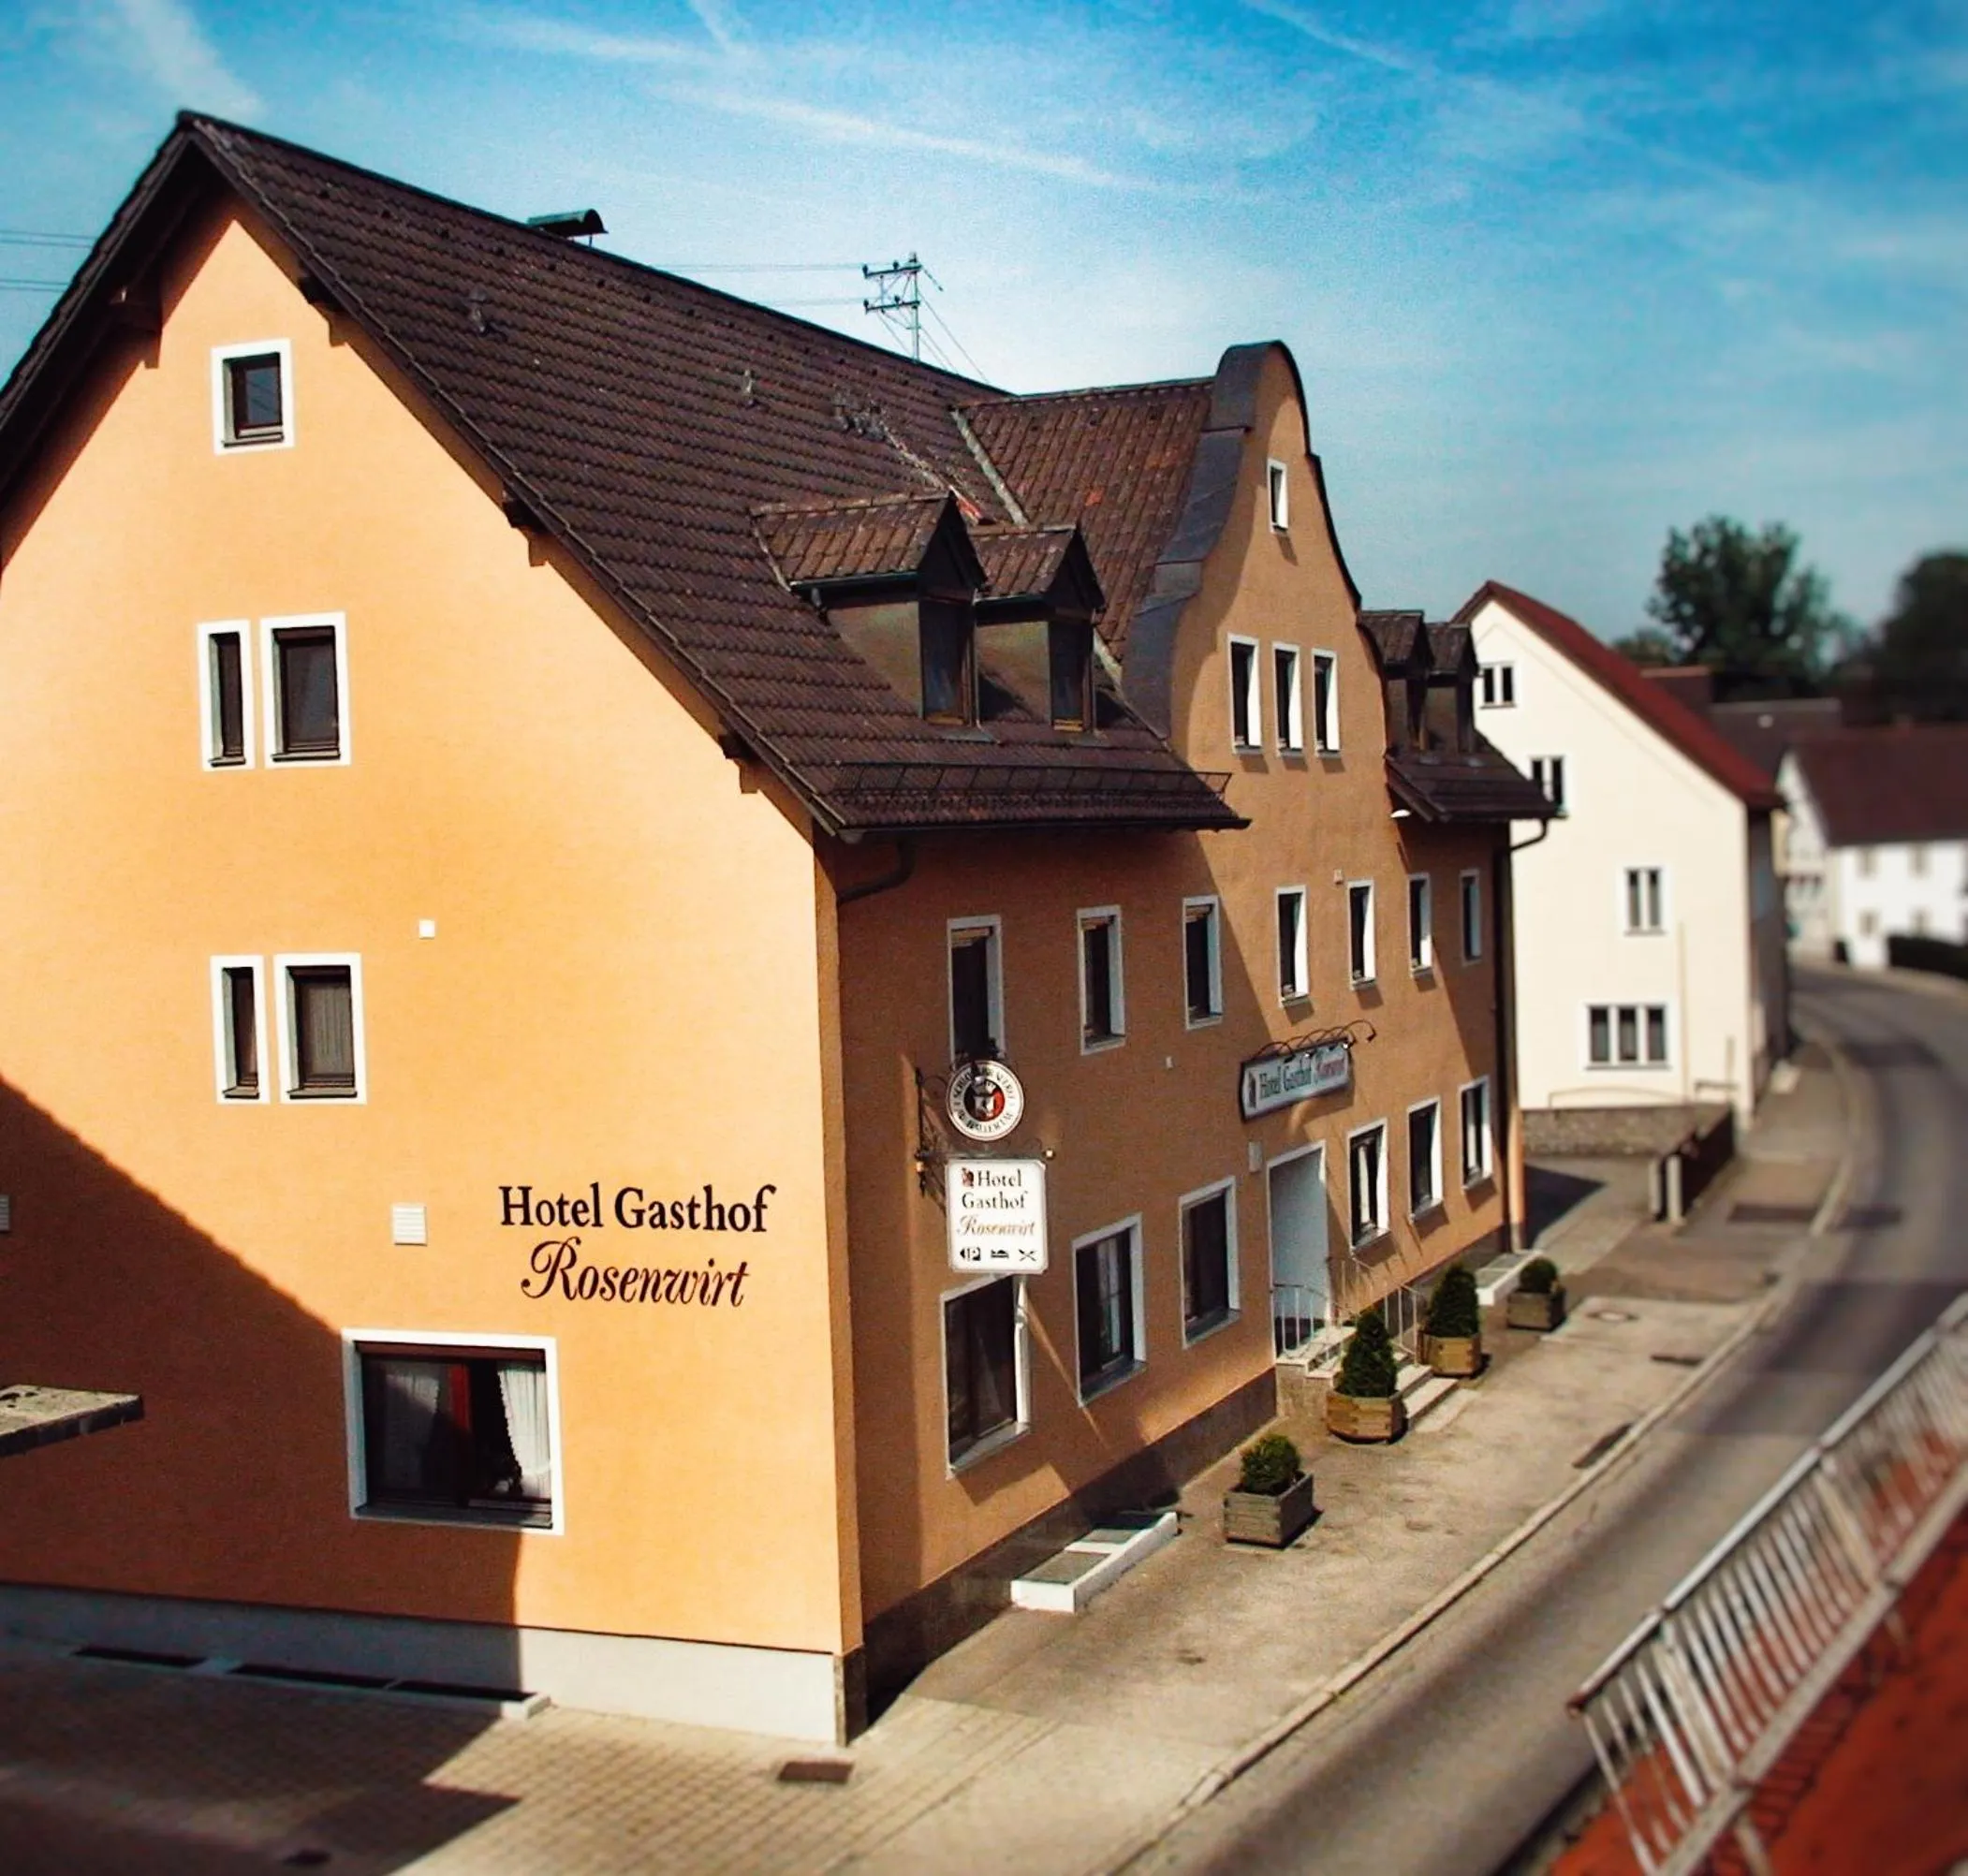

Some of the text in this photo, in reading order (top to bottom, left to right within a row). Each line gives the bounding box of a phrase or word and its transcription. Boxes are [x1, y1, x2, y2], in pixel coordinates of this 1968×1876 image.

[977, 1168, 1022, 1187] Hotel
[498, 1181, 777, 1232] Hotel Gasthof
[962, 1191, 1028, 1209] Gasthof
[957, 1214, 1035, 1236] Rosenwirt
[521, 1236, 750, 1307] Rosenwirt
